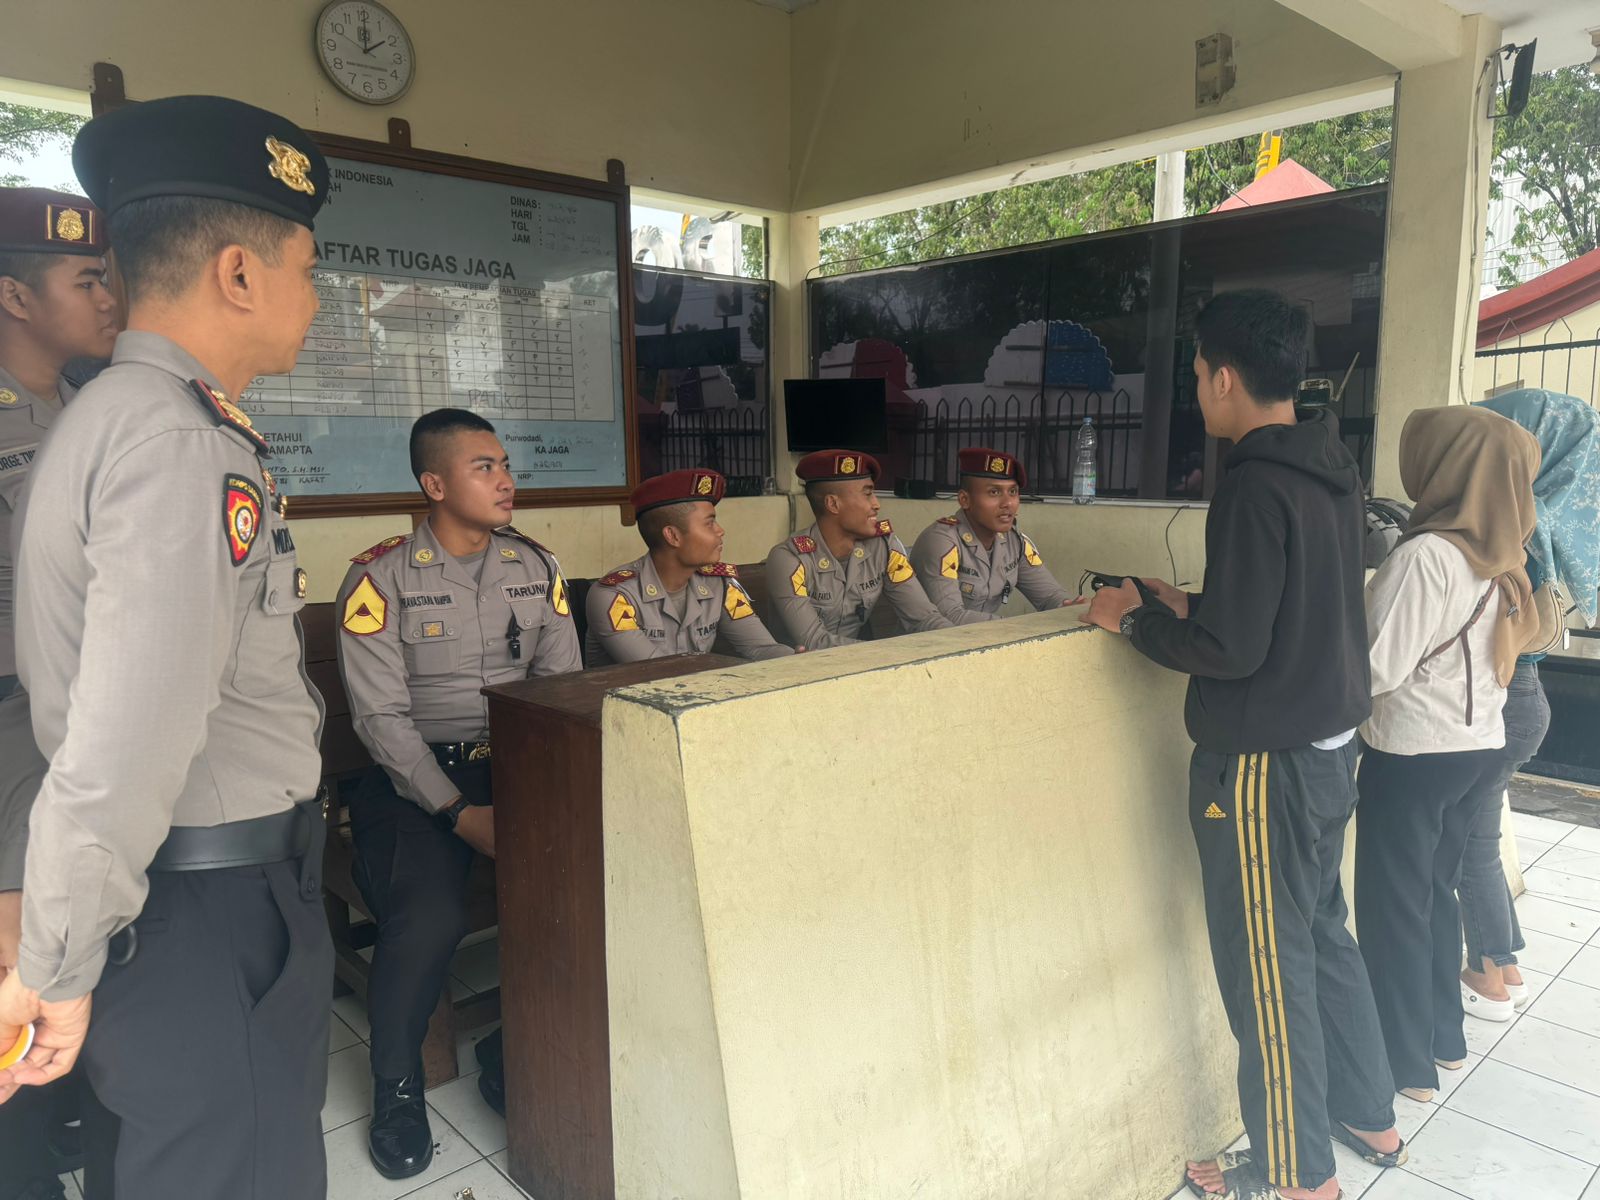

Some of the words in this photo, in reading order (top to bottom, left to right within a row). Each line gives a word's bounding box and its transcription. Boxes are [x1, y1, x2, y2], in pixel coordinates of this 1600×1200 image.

[344, 13, 352, 24] 11
[331, 23, 345, 35] 10
[327, 39, 336, 51] 9
[388, 35, 397, 47] 2
[333, 57, 343, 70] 8
[393, 53, 403, 65] 3
[348, 72, 357, 84] 7
[390, 69, 399, 80] 4
[363, 82, 373, 93] 6
[378, 79, 388, 91] 5
[335, 168, 394, 187] INDONESIA
[511, 209, 532, 220] HARI
[511, 221, 529, 231] TGL
[512, 233, 531, 244] JAM
[314, 241, 381, 266] AFTAR
[386, 249, 458, 274] TUGAS
[463, 258, 516, 281] JAGA
[514, 288, 537, 297] TUGAS
[263, 432, 303, 442] ETAHUI
[268, 444, 313, 455] AMAPTA
[535, 446, 547, 454] KA
[548, 446, 570, 454] JAGA
[505, 586, 546, 598] TARUNA
